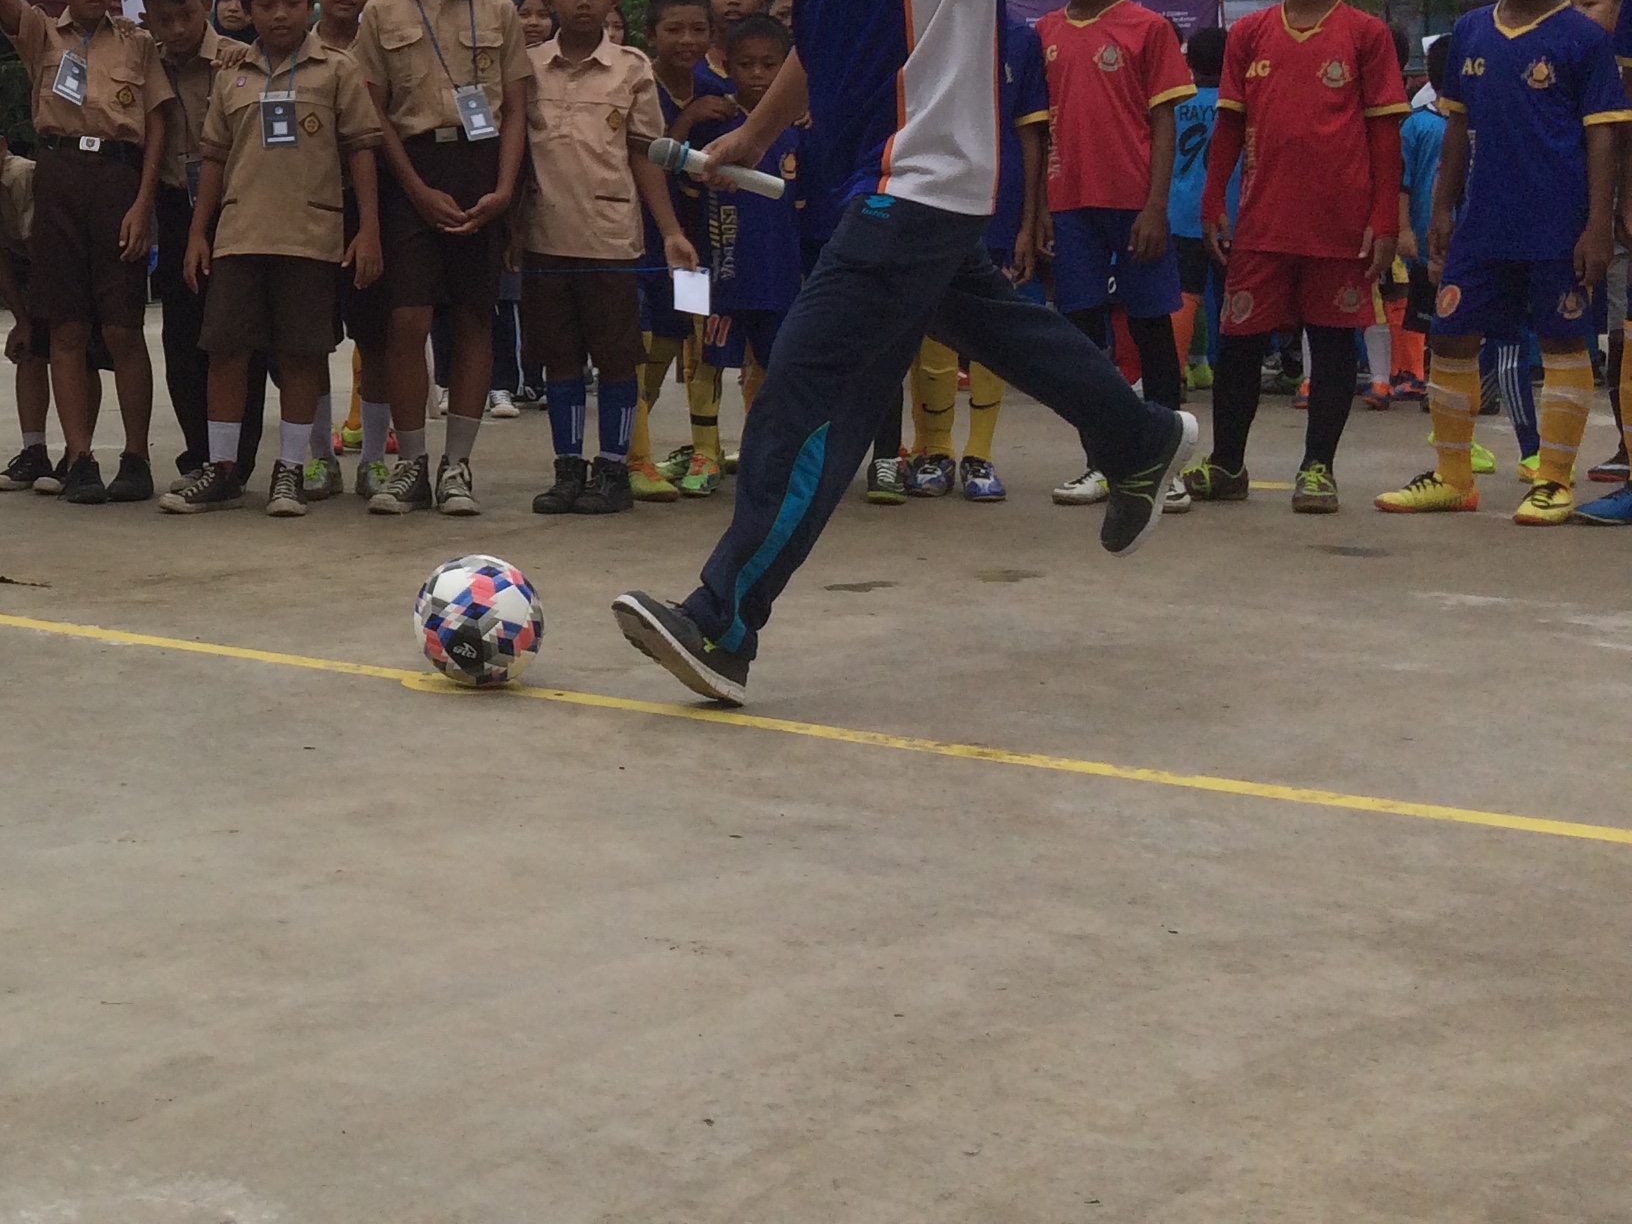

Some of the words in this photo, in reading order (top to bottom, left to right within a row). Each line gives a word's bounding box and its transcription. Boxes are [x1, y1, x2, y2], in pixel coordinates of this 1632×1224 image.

[1245, 60, 1272, 78] AG
[1461, 57, 1486, 76] AG
[1179, 122, 1213, 174] 9
